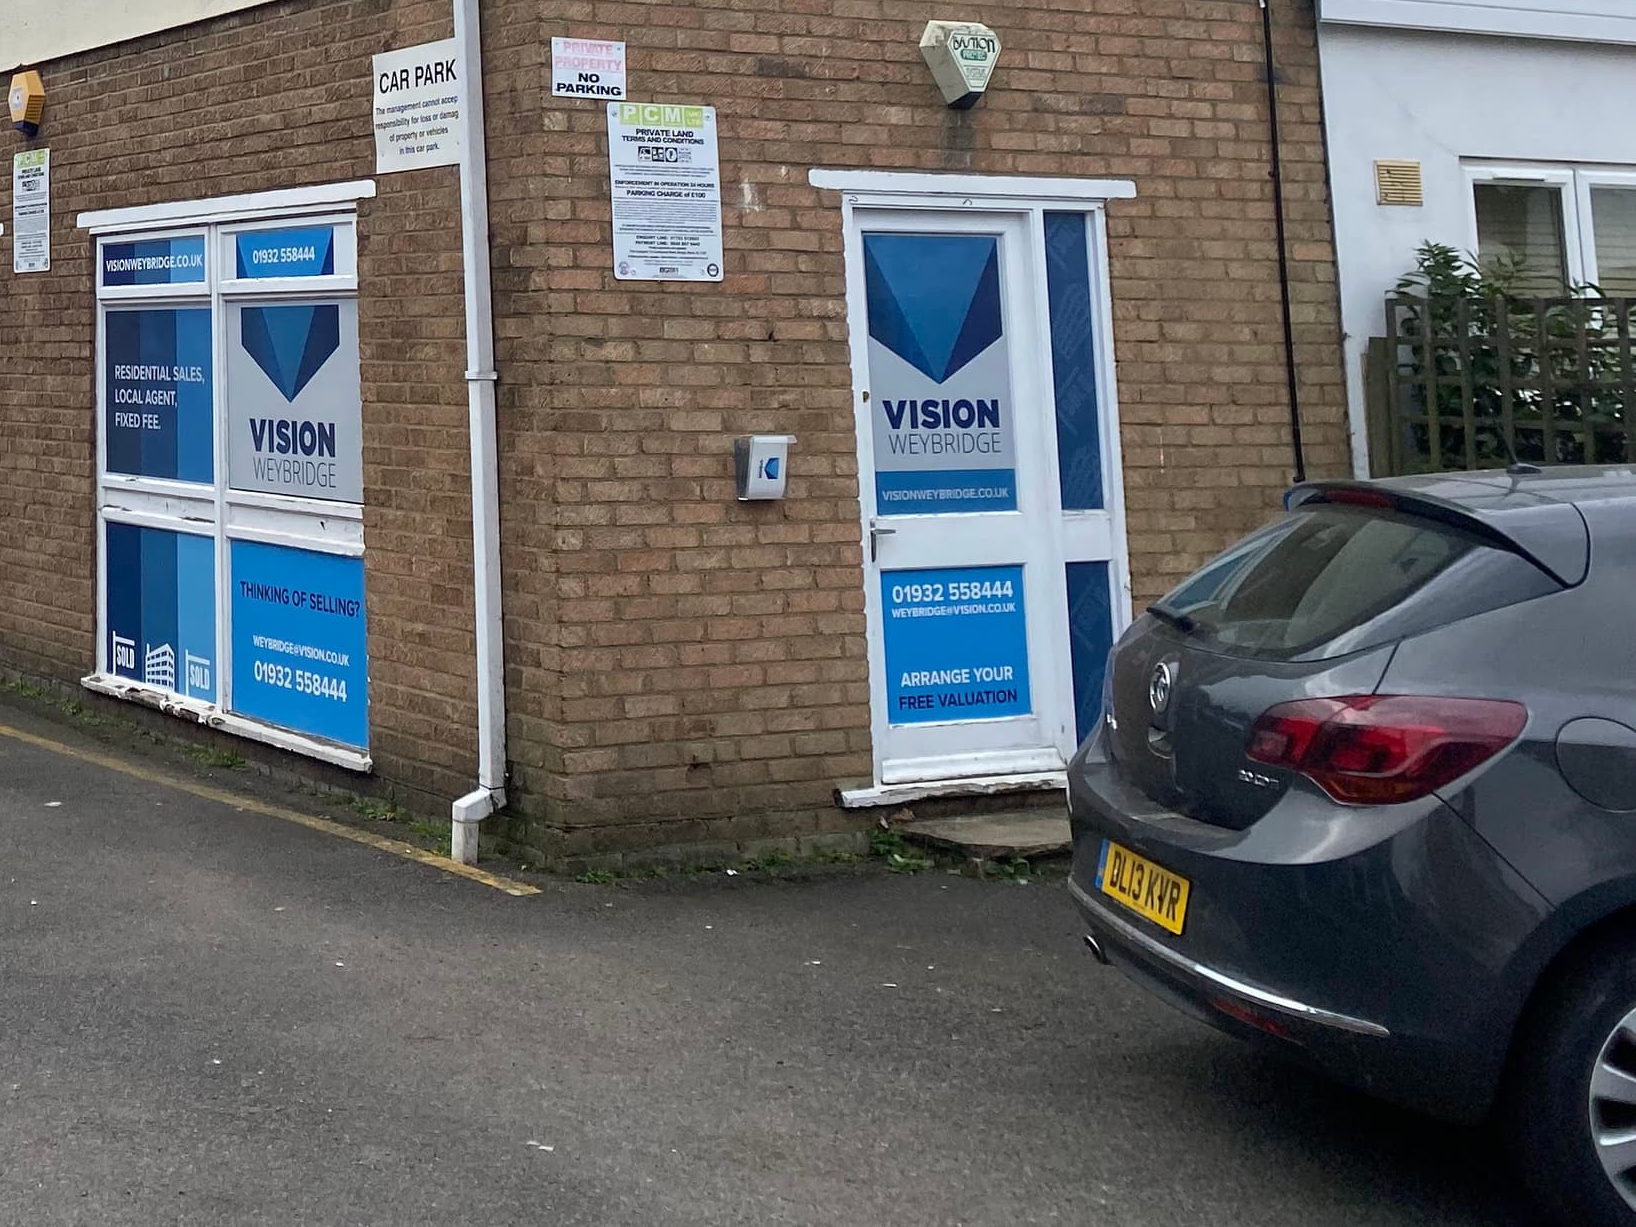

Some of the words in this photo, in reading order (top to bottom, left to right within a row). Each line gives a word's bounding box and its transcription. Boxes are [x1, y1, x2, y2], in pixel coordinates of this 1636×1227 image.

[564, 41, 613, 55] PRIVATE
[555, 55, 621, 70] PROPERTY
[380, 69, 409, 94] CAR
[415, 59, 457, 88] PARK
[578, 72, 600, 83] NO
[556, 82, 622, 96] PARKING
[441, 95, 458, 105] accep
[439, 110, 459, 120] damag
[622, 135, 646, 143] TERMS
[647, 136, 662, 144] AND
[663, 137, 704, 145] CONDITIONS
[635, 128, 671, 137] PRIVATE
[672, 130, 694, 138] LAND
[106, 253, 203, 272] VISIONWEYBRIDGE.CO.UK
[252, 248, 279, 265] 01932
[280, 246, 315, 263] 558444
[115, 365, 171, 381] RESIDENTIAL
[173, 366, 205, 383] SALES,
[115, 389, 143, 405] LOCAL
[145, 390, 178, 408] AGENT,
[115, 412, 140, 429] FIXED
[142, 413, 161, 429] FEE.
[882, 399, 1000, 429] VISION
[249, 418, 336, 458] VISION
[888, 432, 1002, 455] WEYBRIDGE
[253, 456, 336, 489] WEYBRIDGE
[882, 487, 1010, 501] VISIONWEYBRIDGE.CO.UK
[240, 581, 289, 605] THINKING
[292, 590, 307, 607] OF
[309, 593, 360, 618] SELLING?
[892, 584, 944, 604] 01932
[948, 580, 1013, 601] 558444
[892, 602, 1016, 619] WEYBRIDGE@VISION.CO.UK
[116, 645, 135, 669] SOLD
[253, 634, 350, 667] WEYBRIDGE@VISION.CO.UK
[189, 664, 211, 690] SOLD
[254, 660, 292, 689] 01932
[295, 671, 347, 703] 558444
[901, 669, 970, 688] ARRANGE
[973, 666, 1013, 683] YOUR
[899, 694, 934, 711] FREE
[937, 689, 1018, 708] VALUATION
[1109, 850, 1144, 901] DL13
